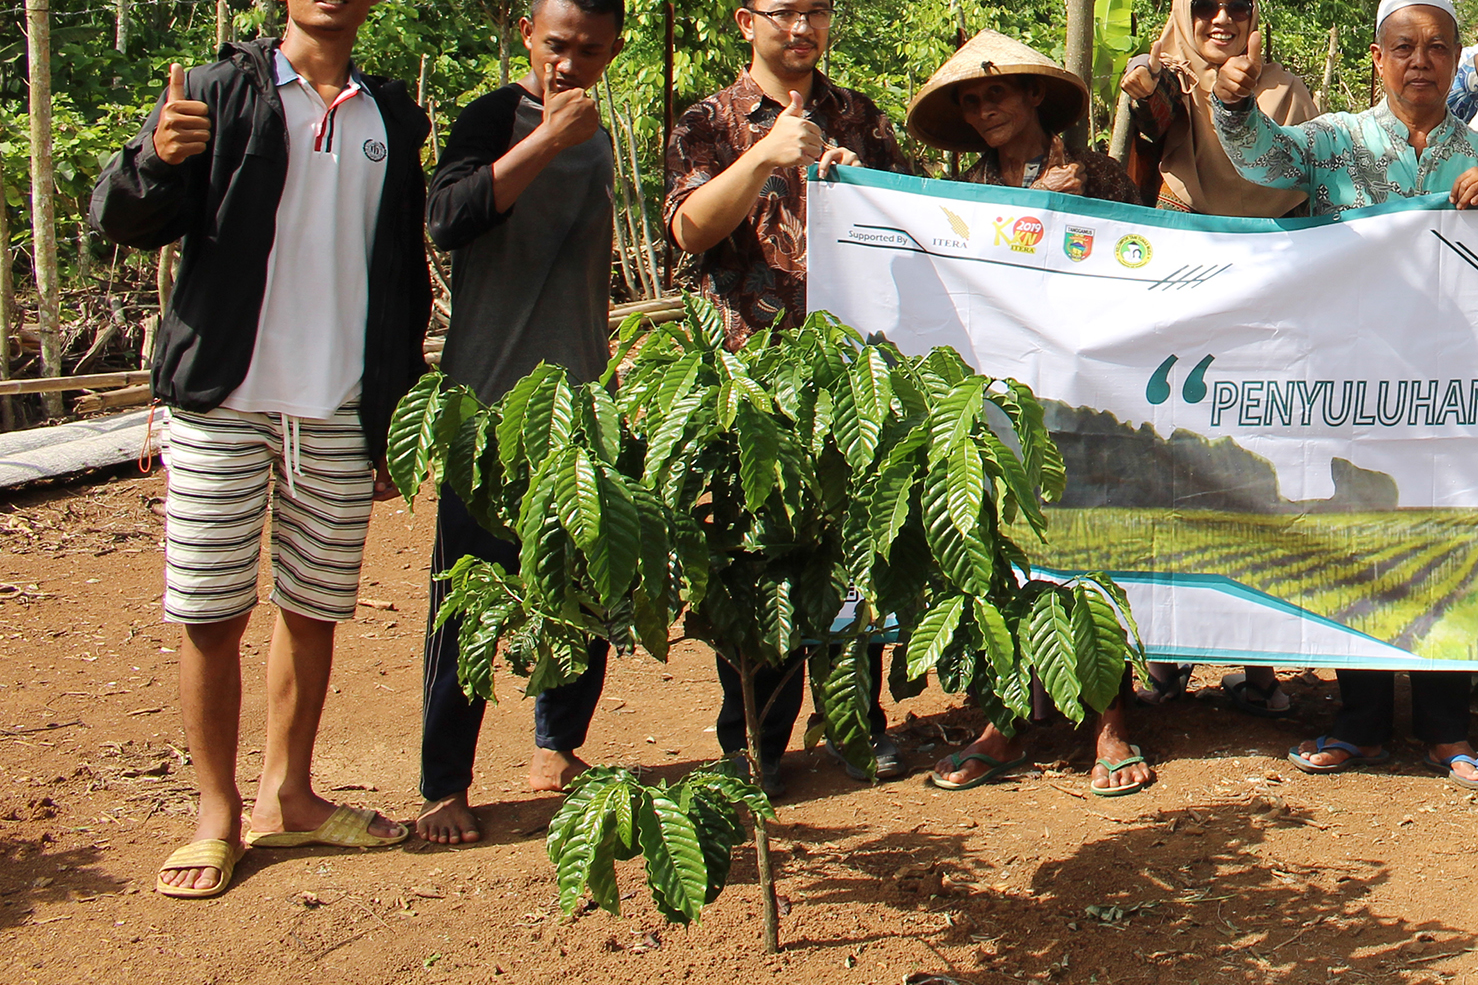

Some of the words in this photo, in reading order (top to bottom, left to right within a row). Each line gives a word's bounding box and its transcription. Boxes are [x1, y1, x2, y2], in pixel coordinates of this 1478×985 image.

[1016, 220, 1042, 233] 2019
[848, 230, 895, 243] Supported
[896, 234, 908, 246] By
[932, 238, 968, 249] ITERA
[1011, 246, 1036, 254] ITERA
